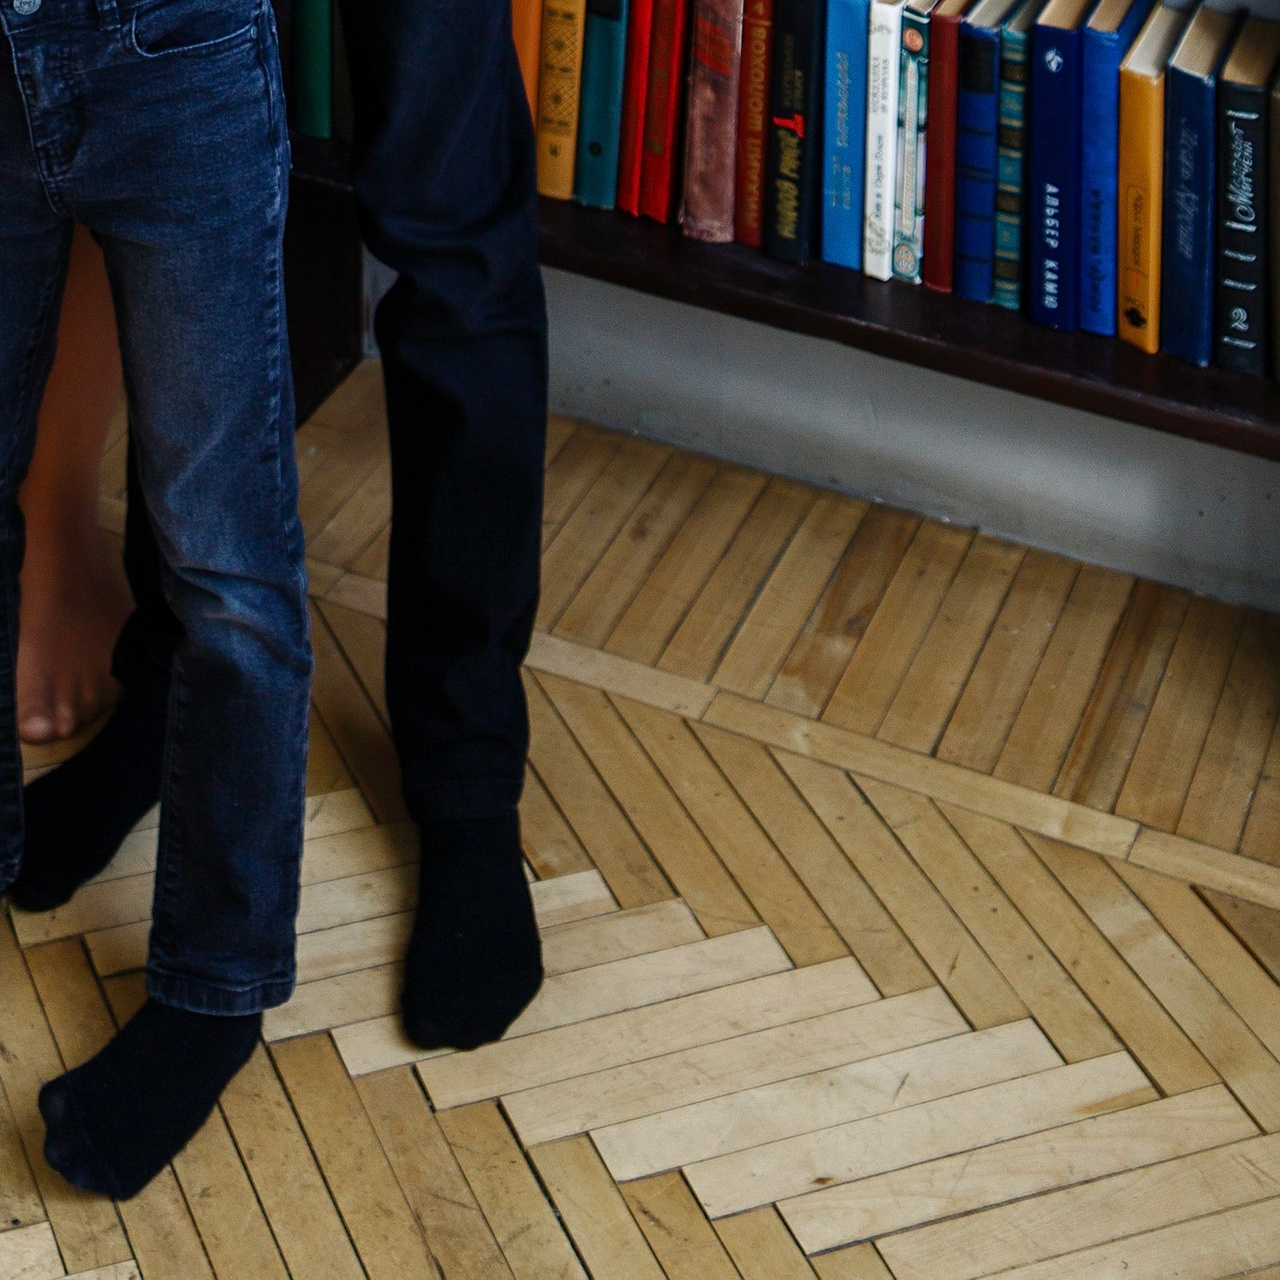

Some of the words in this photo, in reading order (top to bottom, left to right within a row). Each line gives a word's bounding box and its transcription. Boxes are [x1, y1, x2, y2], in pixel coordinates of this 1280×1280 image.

[745, 26, 767, 130] ШОЛОХОВ
[1044, 183, 1059, 247] АЛЬБЕР
[1044, 259, 1058, 308] КАМЮ
